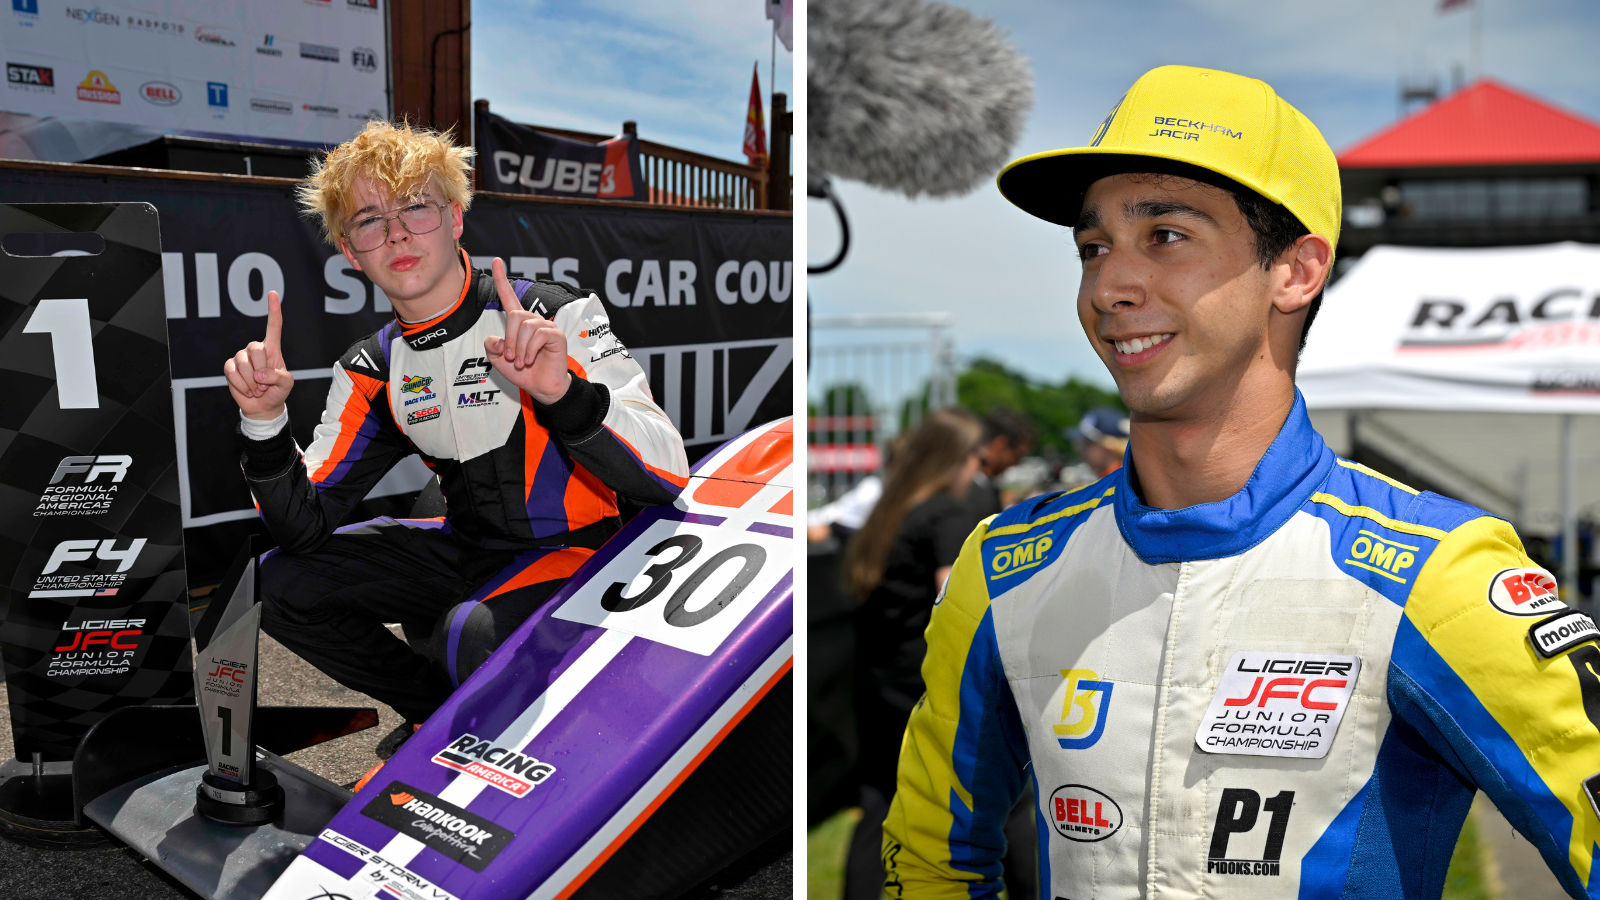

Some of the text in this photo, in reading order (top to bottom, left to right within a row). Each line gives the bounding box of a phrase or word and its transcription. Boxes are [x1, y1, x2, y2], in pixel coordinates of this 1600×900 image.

[1149, 129, 1200, 142] JACIR
[1154, 116, 1243, 140] BECKHAM
[604, 257, 697, 308] CAR
[410, 328, 448, 347] TORQ
[22, 298, 100, 409] 1
[458, 357, 493, 375] F4
[403, 379, 431, 392] SUNOCO
[404, 392, 437, 406] RACE FUELS
[457, 390, 501, 405] MLT
[415, 406, 440, 417] SCCA
[49, 455, 133, 484] FR
[44, 485, 118, 494] FORMULA
[36, 501, 112, 510] AMERICAS
[40, 494, 114, 502] REGIONAL
[33, 509, 108, 517] CHAMPIONSHIP
[41, 538, 148, 575] F4
[992, 536, 1053, 572] OMP
[1351, 536, 1415, 573] OMP
[33, 581, 123, 590] CHAMPIONSHIP
[36, 573, 128, 584] UNITED STATES
[601, 534, 767, 628] 30
[62, 619, 147, 631] LIGIER
[55, 630, 143, 652] JFC
[52, 651, 135, 660] JUNIOR
[49, 659, 131, 668] FORMULA
[211, 657, 248, 670] LIGIER
[1237, 658, 1353, 676] LIGIER
[47, 667, 129, 677] CHAMPIONSHIP
[208, 665, 247, 683] JFC
[206, 677, 243, 688] JUNIOR
[1223, 676, 1347, 711] JFC
[1216, 709, 1330, 724] JUNIOR
[217, 705, 232, 757] 1
[1210, 723, 1322, 737] FORMULA
[1205, 736, 1319, 751] CHAMPIONSHIP
[449, 735, 552, 782] RACING
[218, 762, 239, 773] RACING
[467, 764, 519, 792] AMERICA
[1054, 797, 1109, 828] BELL
[1060, 824, 1100, 836] HELMETS
[1208, 788, 1296, 860] P1
[411, 819, 482, 861] Competition
[322, 831, 453, 900] LIGIER STORM V
[1207, 861, 1280, 876] P1DOKS.COM
[370, 869, 389, 882] by
